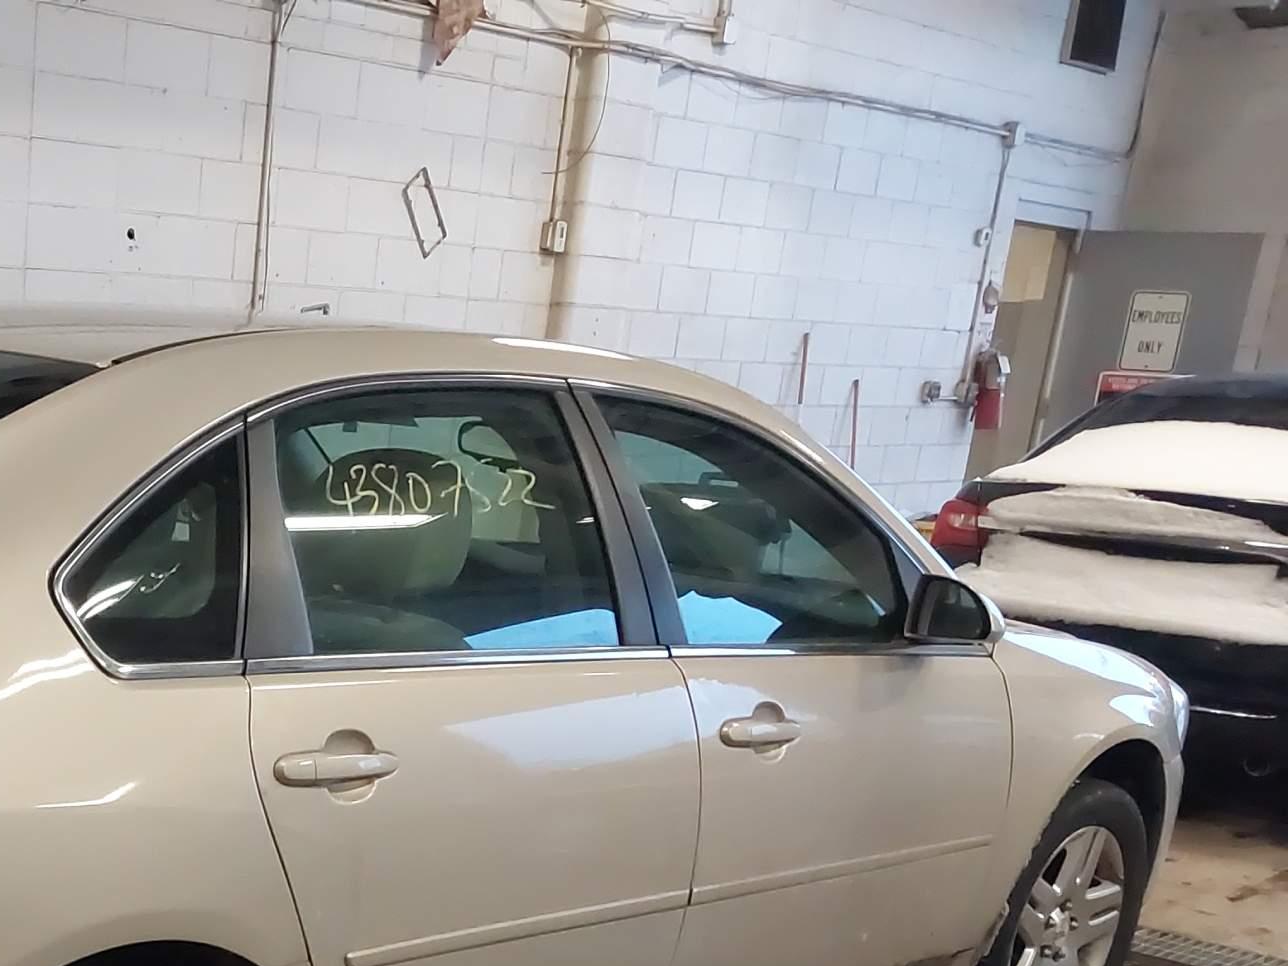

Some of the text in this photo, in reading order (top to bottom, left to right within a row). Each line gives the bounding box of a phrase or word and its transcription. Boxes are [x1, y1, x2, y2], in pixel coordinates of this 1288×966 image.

[1131, 309, 1183, 324] EMPLOYEES
[1137, 340, 1163, 353] ONLY
[325, 458, 556, 518] 43807522
